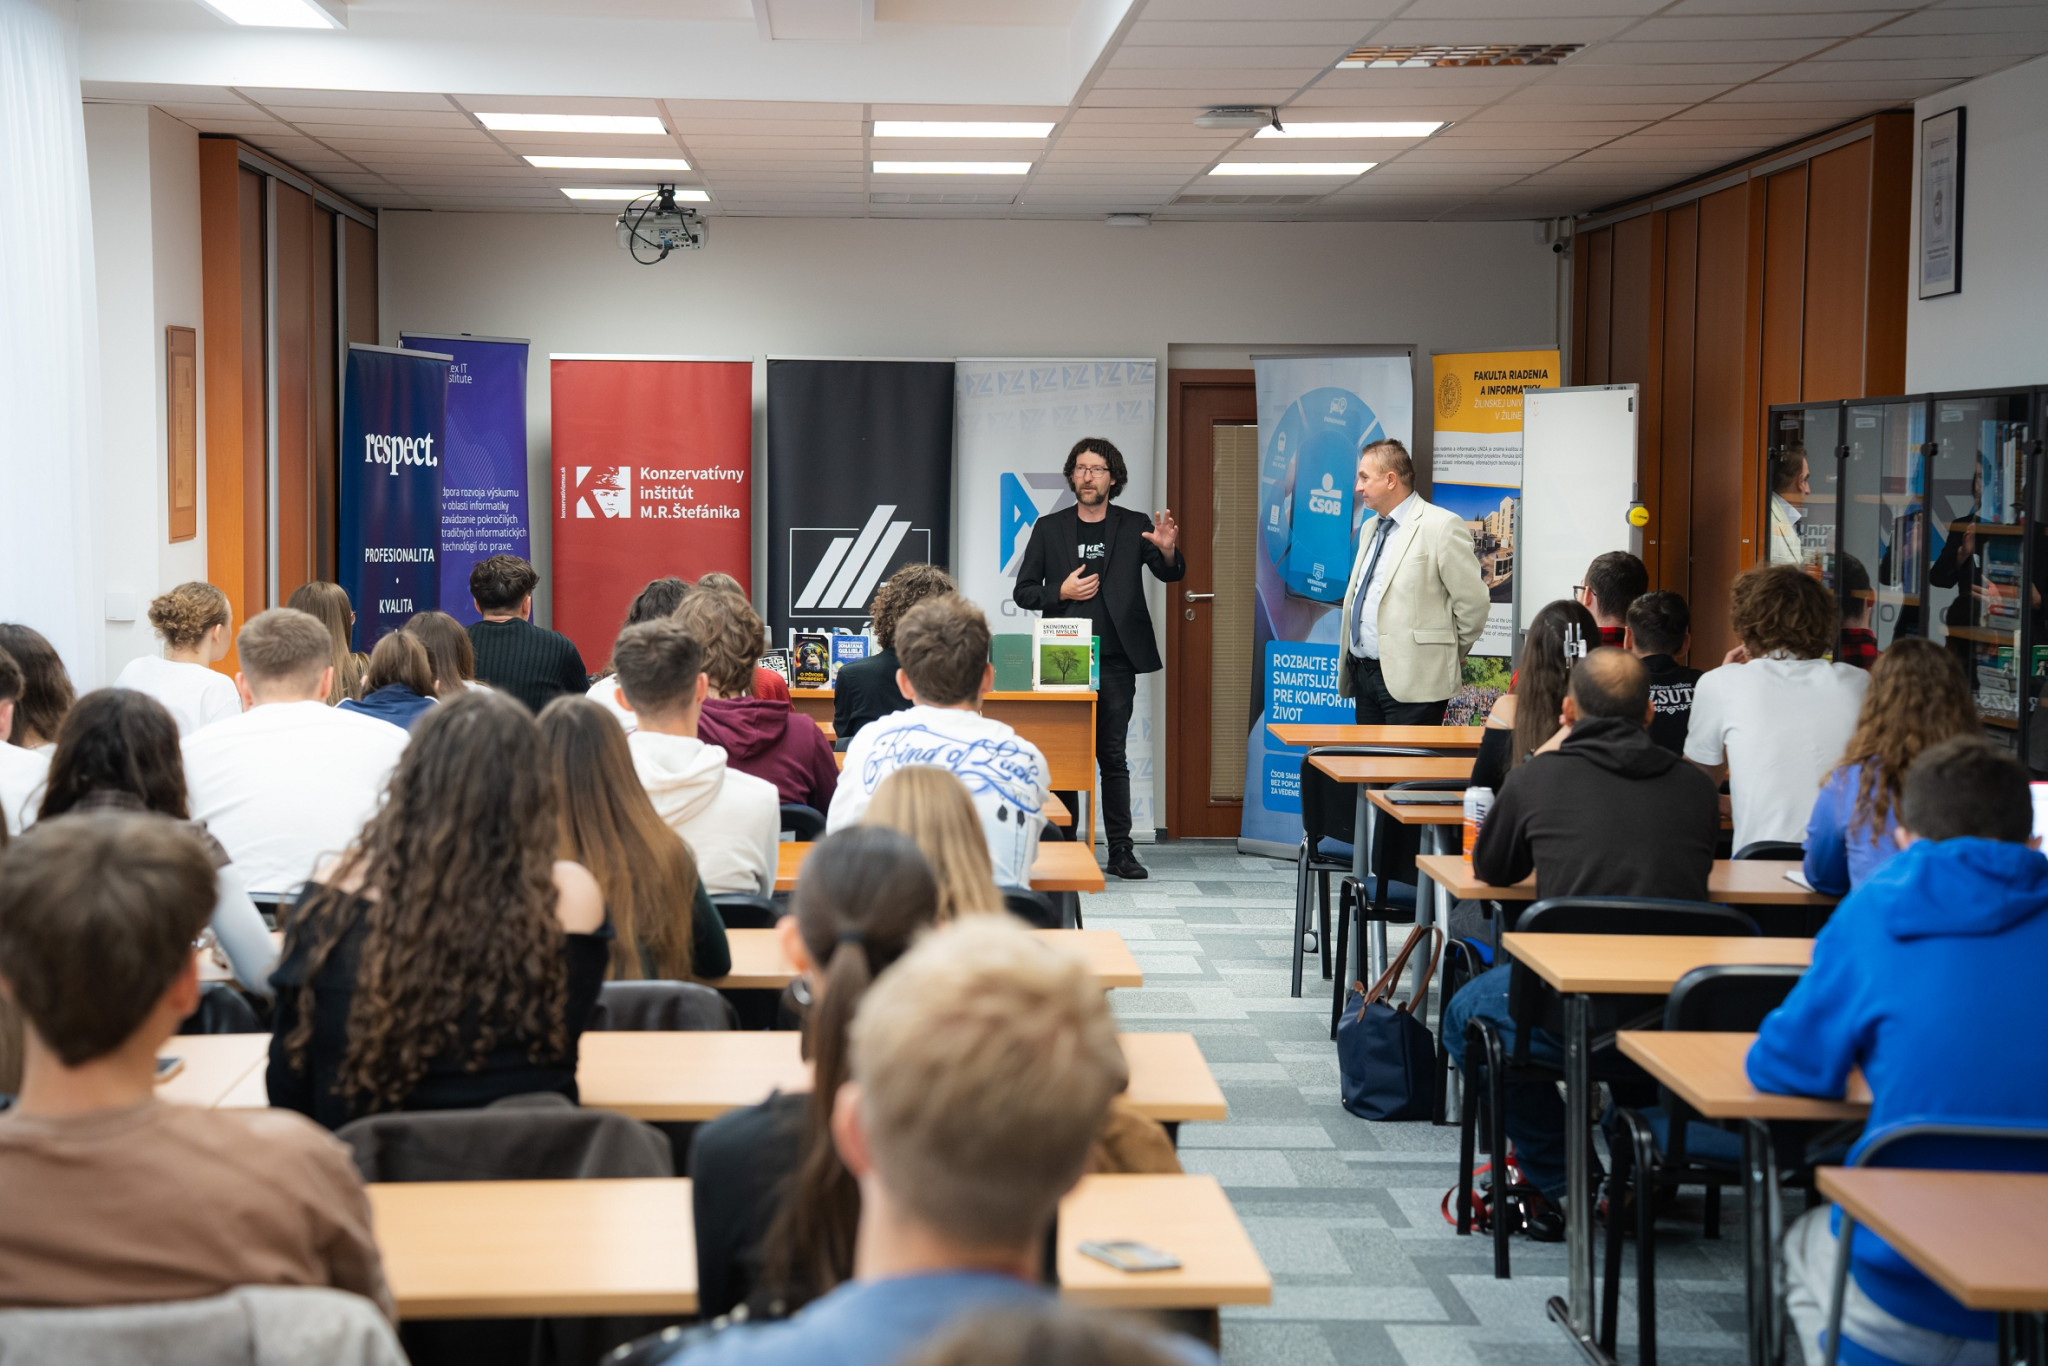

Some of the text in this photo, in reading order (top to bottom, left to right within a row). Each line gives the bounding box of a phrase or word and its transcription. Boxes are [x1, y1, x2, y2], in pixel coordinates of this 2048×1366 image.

[450, 363, 467, 373] ex IT
[1474, 369, 1548, 381] FAKULTA RIADENIA
[1480, 385, 1485, 395] A
[1473, 398, 1523, 409] ŽILINSKEJ UNIV
[1495, 411, 1522, 420] V ŽILINE
[640, 465, 745, 483] Konzervatívny
[461, 489, 485, 499] rozvoja
[487, 487, 519, 499] výskumu
[640, 485, 694, 500] inštitút
[448, 501, 468, 511] oblasti
[470, 501, 510, 513] informatiky
[640, 502, 741, 519] M.R.Štefánika
[1309, 496, 1341, 516] ČSOB
[441, 513, 519, 526] zavádzanie pokročilých
[475, 527, 528, 540] informatických
[478, 541, 488, 551] do
[489, 542, 514, 553] praxe.
[364, 547, 435, 563] PROFESIONALITA
[379, 598, 414, 614] KVALITA
[1273, 653, 1327, 671] ROZBAĽTE
[1273, 688, 1293, 703] PRE
[1272, 705, 1303, 722] ŽIVOT
[1270, 769, 1300, 780] ČSOB SMAR
[1270, 779, 1281, 787] BEZ
[1270, 788, 1300, 798] ZA VEDENIE
